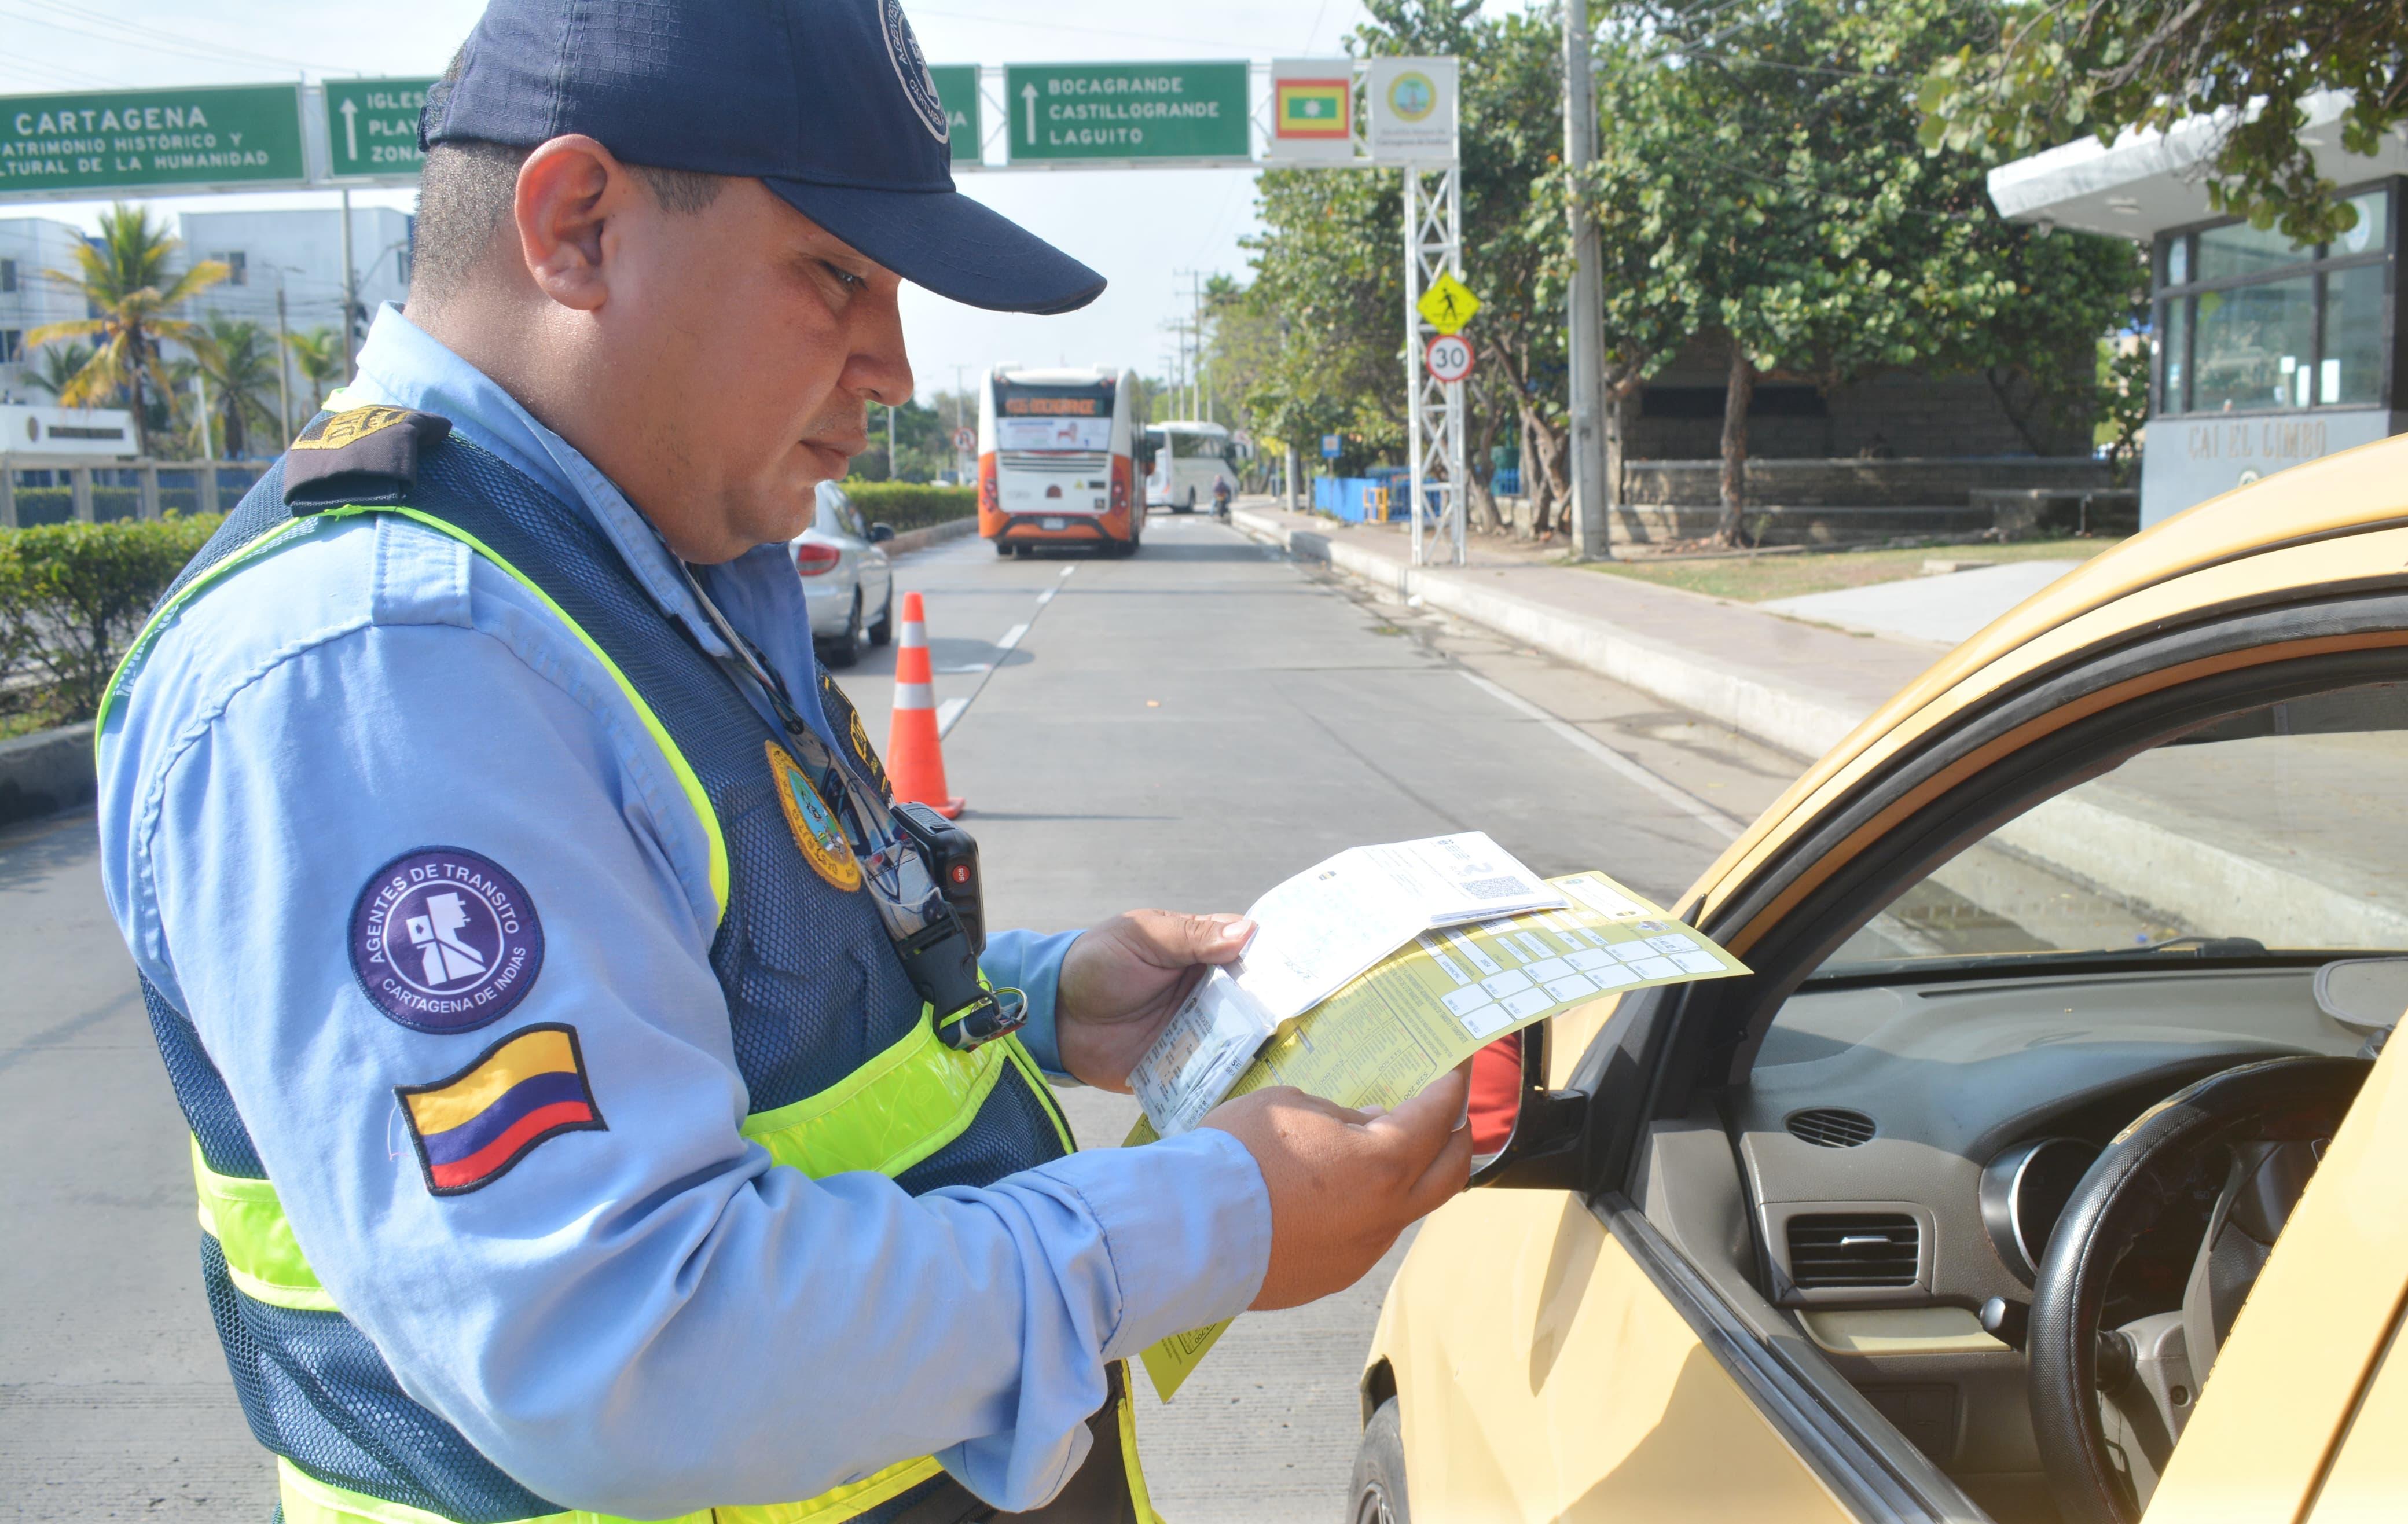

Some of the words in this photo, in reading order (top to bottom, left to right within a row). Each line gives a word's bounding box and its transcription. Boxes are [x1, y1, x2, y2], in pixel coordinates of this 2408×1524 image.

[1048, 77, 1183, 95] BOCAGRANDE
[367, 91, 426, 109] IGLES
[15, 105, 208, 135] CARTAGENA
[1049, 101, 1220, 120] CASTILLOGRANDE
[369, 119, 418, 136] PLAY
[1050, 127, 1143, 145] LAGUITO
[1, 138, 106, 157] ATRIMONIO
[230, 133, 242, 146] Y
[0, 160, 69, 177] TURAL
[78, 157, 103, 174] DE
[116, 156, 142, 171] LA
[155, 150, 269, 170] HUMANIDAD
[1436, 348, 1464, 368] 30
[366, 876, 408, 963] AGENTES
[410, 864, 439, 883] DE
[443, 864, 519, 934] TRANSITO
[383, 978, 473, 1013] CARTAGENA
[474, 986, 497, 1006] DE
[496, 946, 526, 991] INDIAS
